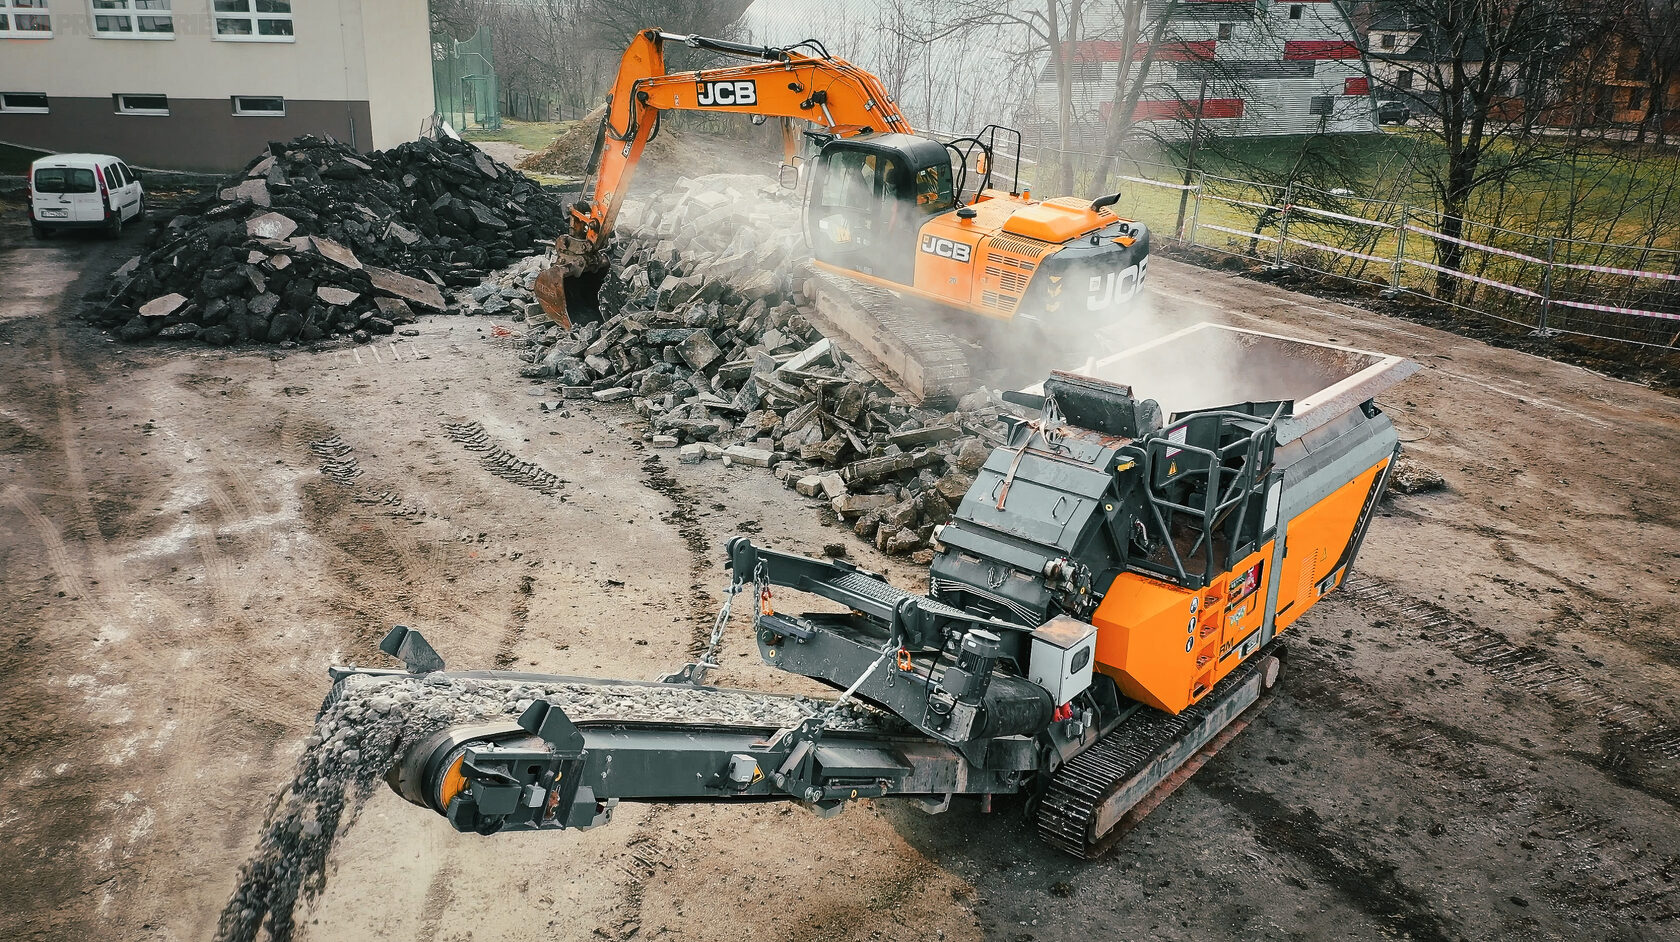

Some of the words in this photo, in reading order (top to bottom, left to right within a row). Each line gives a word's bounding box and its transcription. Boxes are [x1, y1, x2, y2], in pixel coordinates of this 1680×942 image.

[698, 81, 756, 105] JCB
[922, 237, 970, 262] JCB
[1086, 254, 1149, 311] JCB
